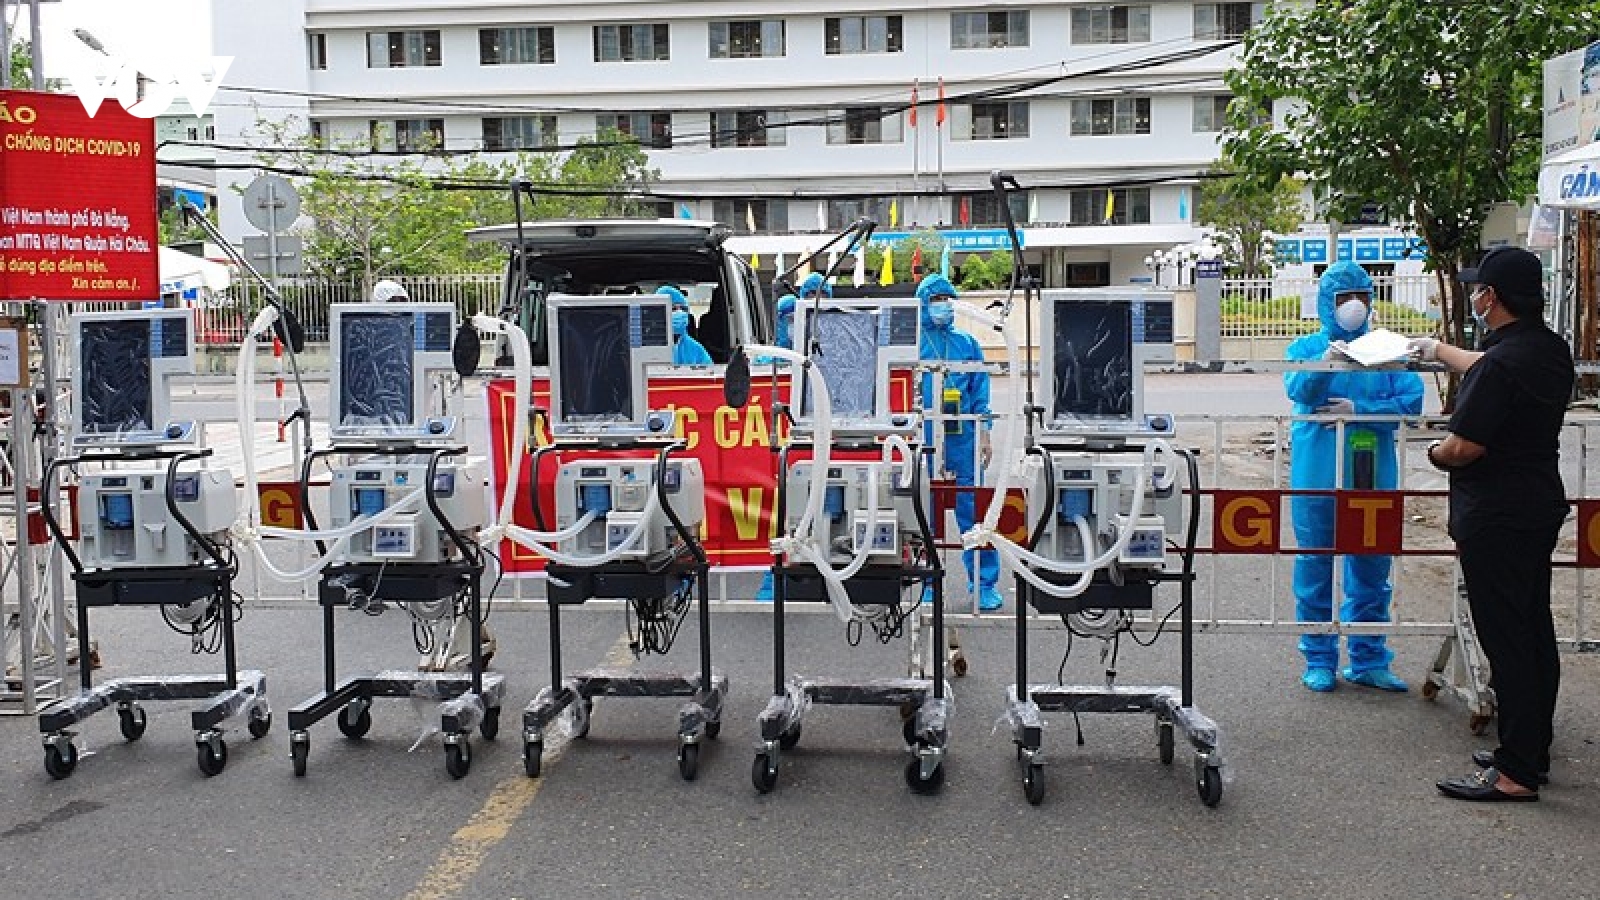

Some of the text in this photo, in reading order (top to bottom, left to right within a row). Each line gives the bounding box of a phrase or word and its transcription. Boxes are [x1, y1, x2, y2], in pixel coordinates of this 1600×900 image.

[5, 128, 141, 158] CHỐNG DỊCH COVID-19
[21, 208, 43, 225] Nam
[61, 233, 83, 251] Nam
[1219, 496, 1273, 547] G
[1347, 499, 1394, 547] T
